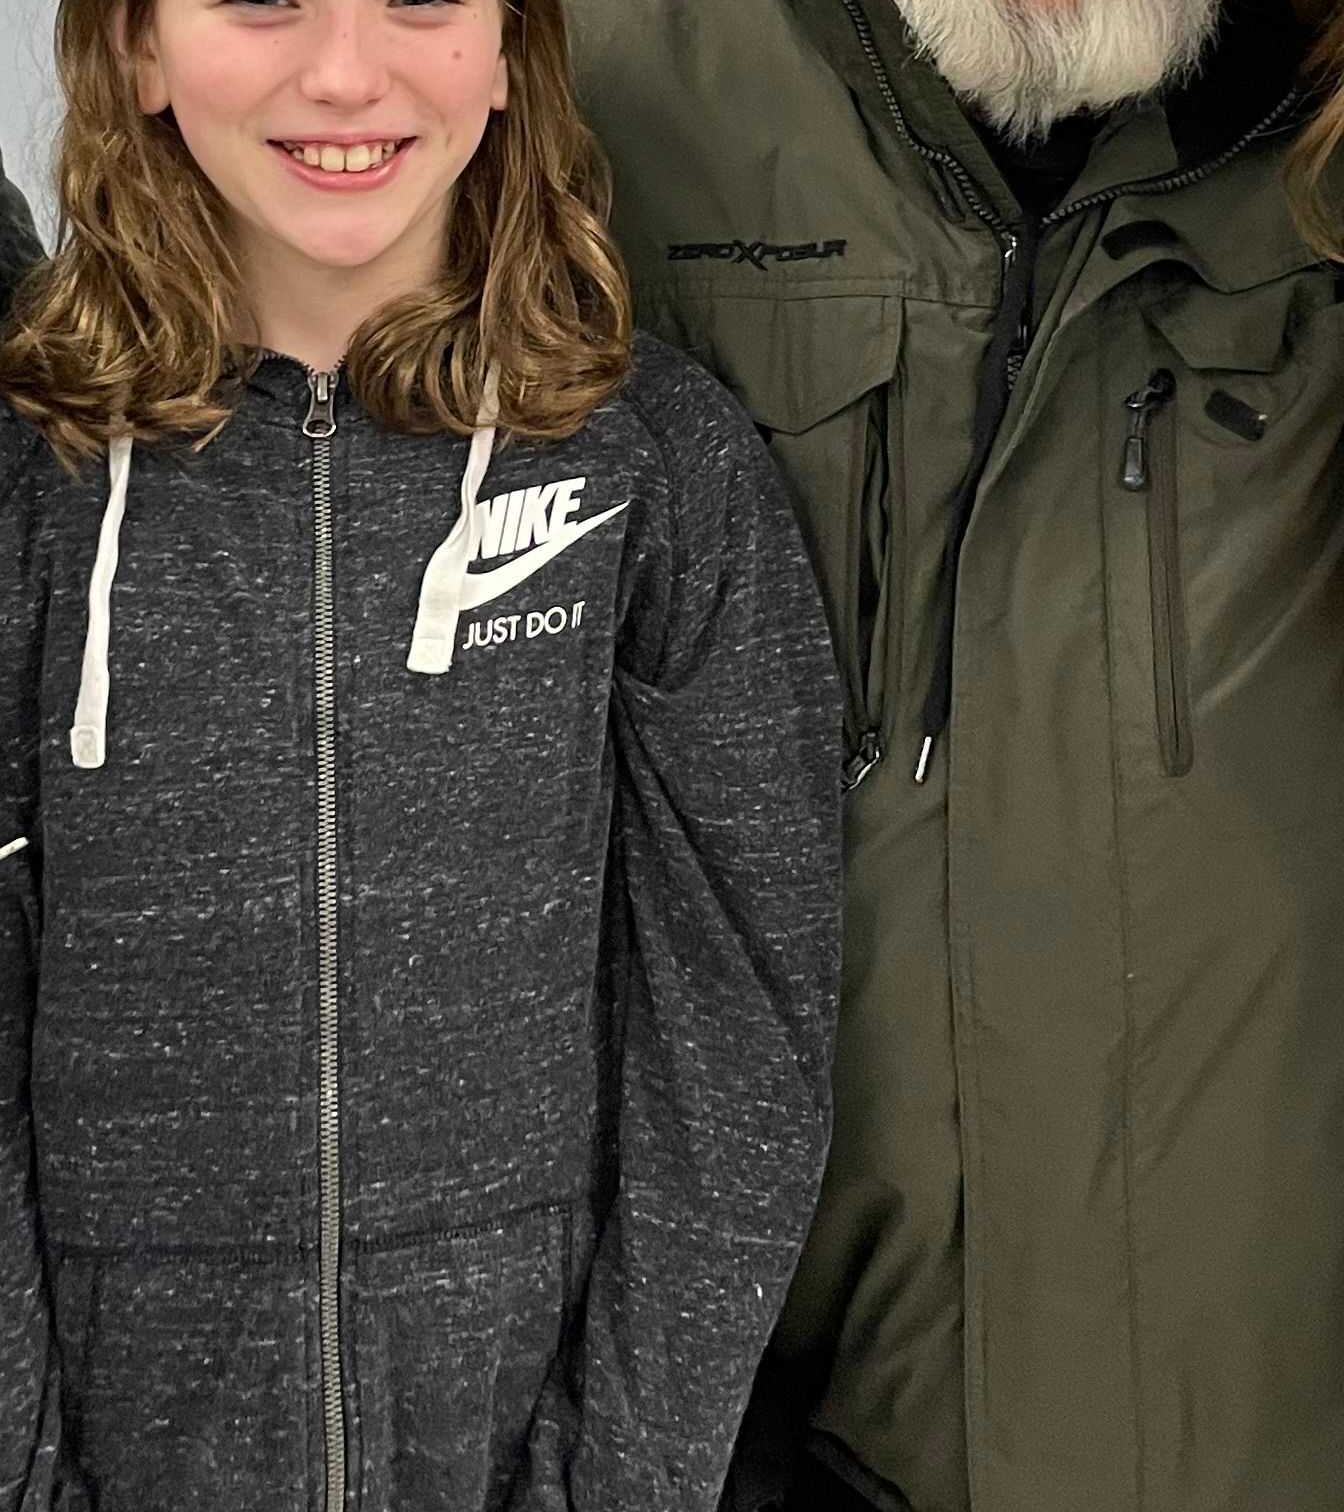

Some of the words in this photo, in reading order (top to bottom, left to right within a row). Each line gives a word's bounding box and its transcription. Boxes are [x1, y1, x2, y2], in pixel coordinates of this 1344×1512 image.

[468, 476, 587, 563] NIKE
[462, 615, 522, 650] JUST
[526, 606, 568, 639] DO
[571, 600, 586, 629] IT
